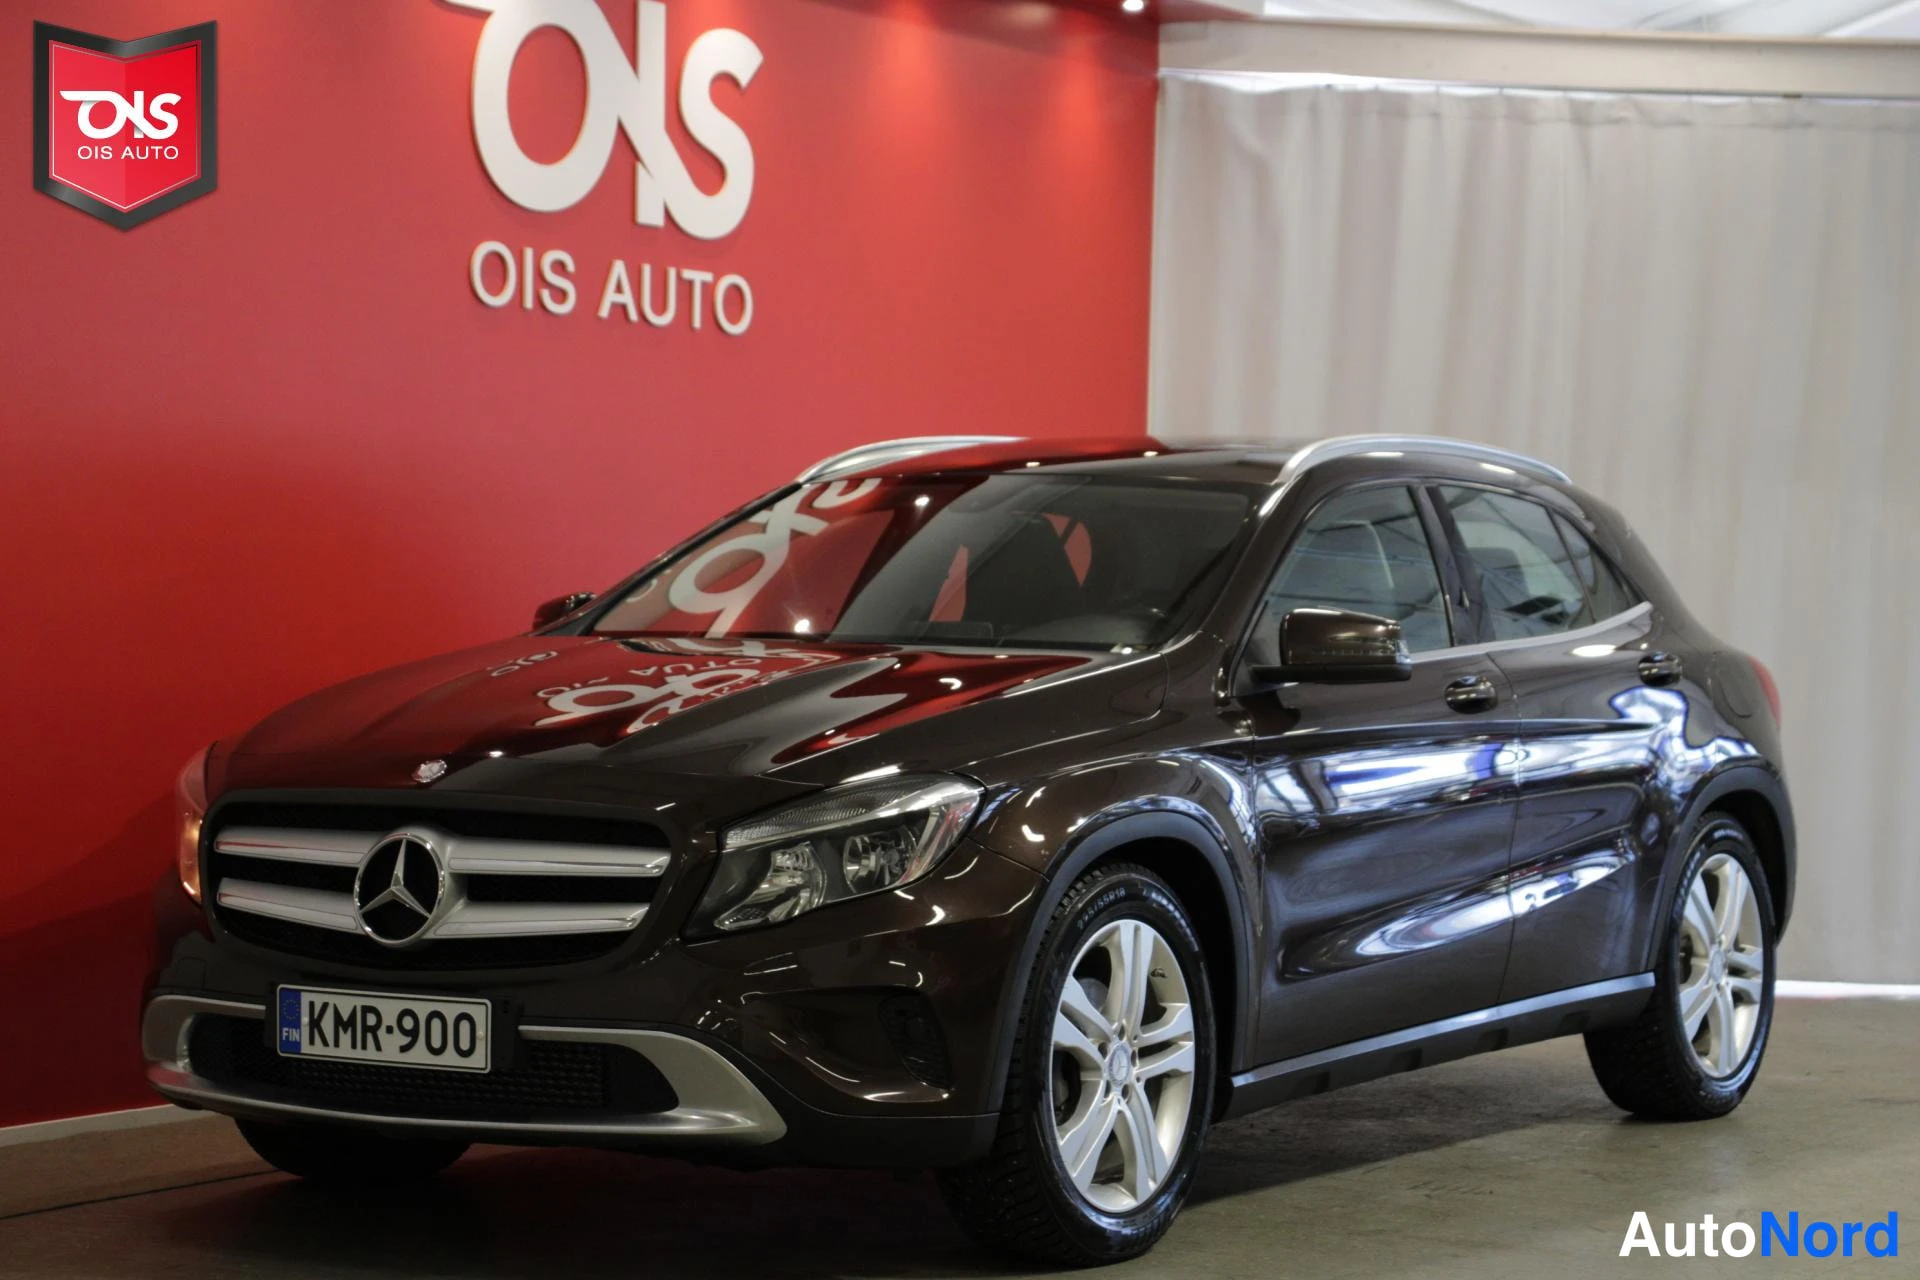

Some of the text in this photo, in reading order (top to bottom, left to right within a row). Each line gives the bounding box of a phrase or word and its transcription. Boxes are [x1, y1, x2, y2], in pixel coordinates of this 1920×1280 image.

[470, 240, 754, 336] OIS AUTO
[281, 1027, 300, 1042] FIN
[308, 1000, 477, 1059] KMR-900
